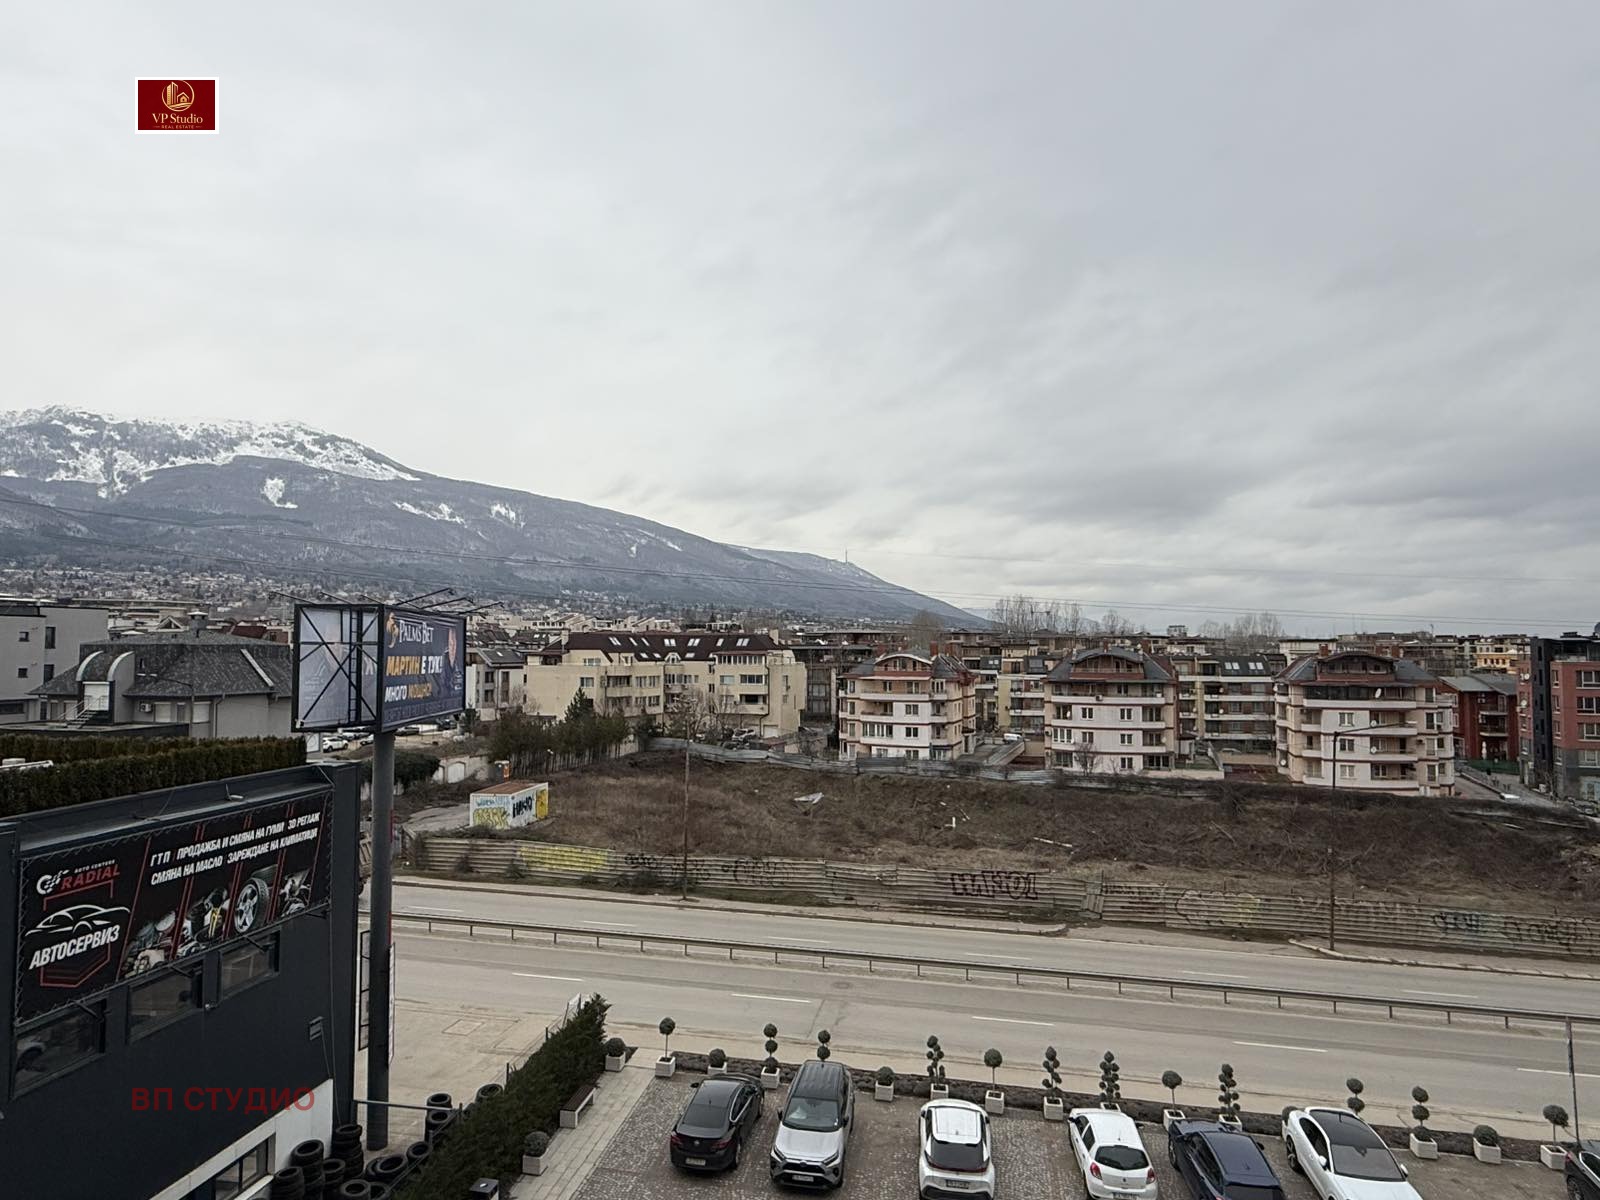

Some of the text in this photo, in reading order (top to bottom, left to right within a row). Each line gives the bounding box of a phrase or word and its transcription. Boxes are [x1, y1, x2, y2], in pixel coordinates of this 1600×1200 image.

[386, 655, 443, 676] МАРТИН Е ТУК!
[384, 685, 408, 702] МНОГО
[177, 839, 221, 860] ПРОДАЖБА
[222, 836, 230, 849] И
[229, 829, 255, 846] СМЯНА
[255, 826, 265, 839] НА
[264, 821, 285, 837] ГУМИ
[296, 812, 321, 827] РЕГЛАЖ
[151, 828, 318, 886] СМЯНА НА МАСЛО ЗАРЕЖДАНЕ НА КЛИМАТИЦИ
[61, 863, 120, 890] RADIAL
[29, 924, 120, 970] АВТОСЕРВИЗ
